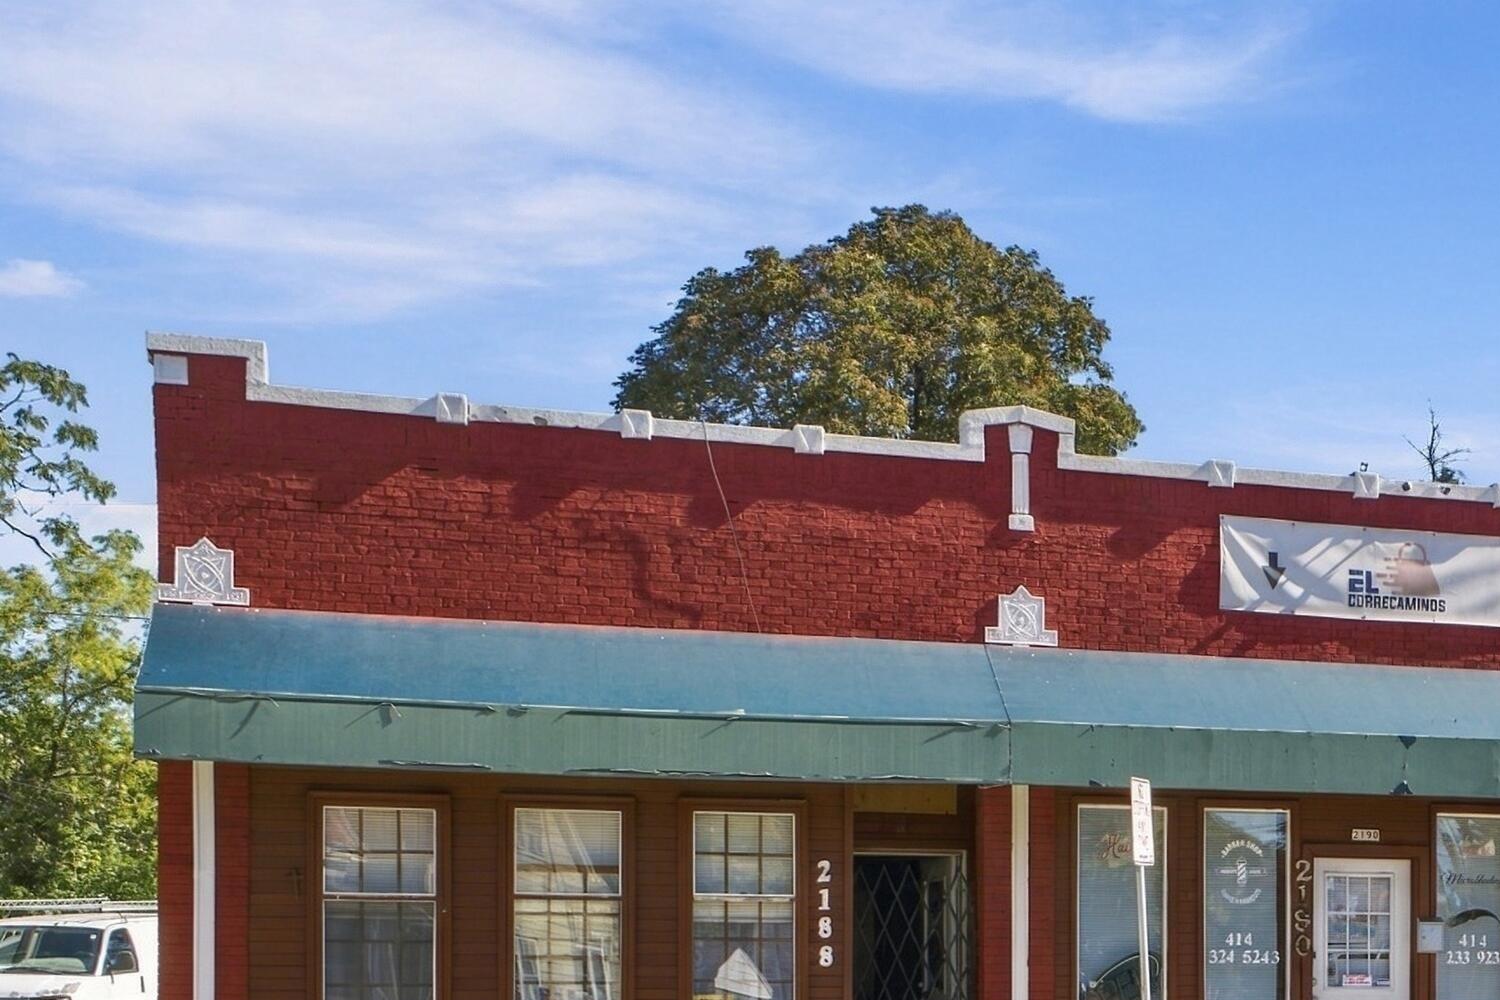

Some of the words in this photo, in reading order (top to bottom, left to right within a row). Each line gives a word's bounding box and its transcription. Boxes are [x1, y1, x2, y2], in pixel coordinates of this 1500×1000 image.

[1348, 569, 1379, 594] EL
[1348, 594, 1446, 612] CORRECAMINOS
[1353, 830, 1378, 840] 2190
[1221, 840, 1245, 856] BARBER
[1246, 841, 1263, 855] SHOP
[817, 860, 833, 967] 2188
[1226, 932, 1252, 946] 414
[1459, 934, 1487, 947] 414
[1209, 949, 1234, 963] 324
[1242, 950, 1280, 964] 5243
[1446, 951, 1470, 964] 233
